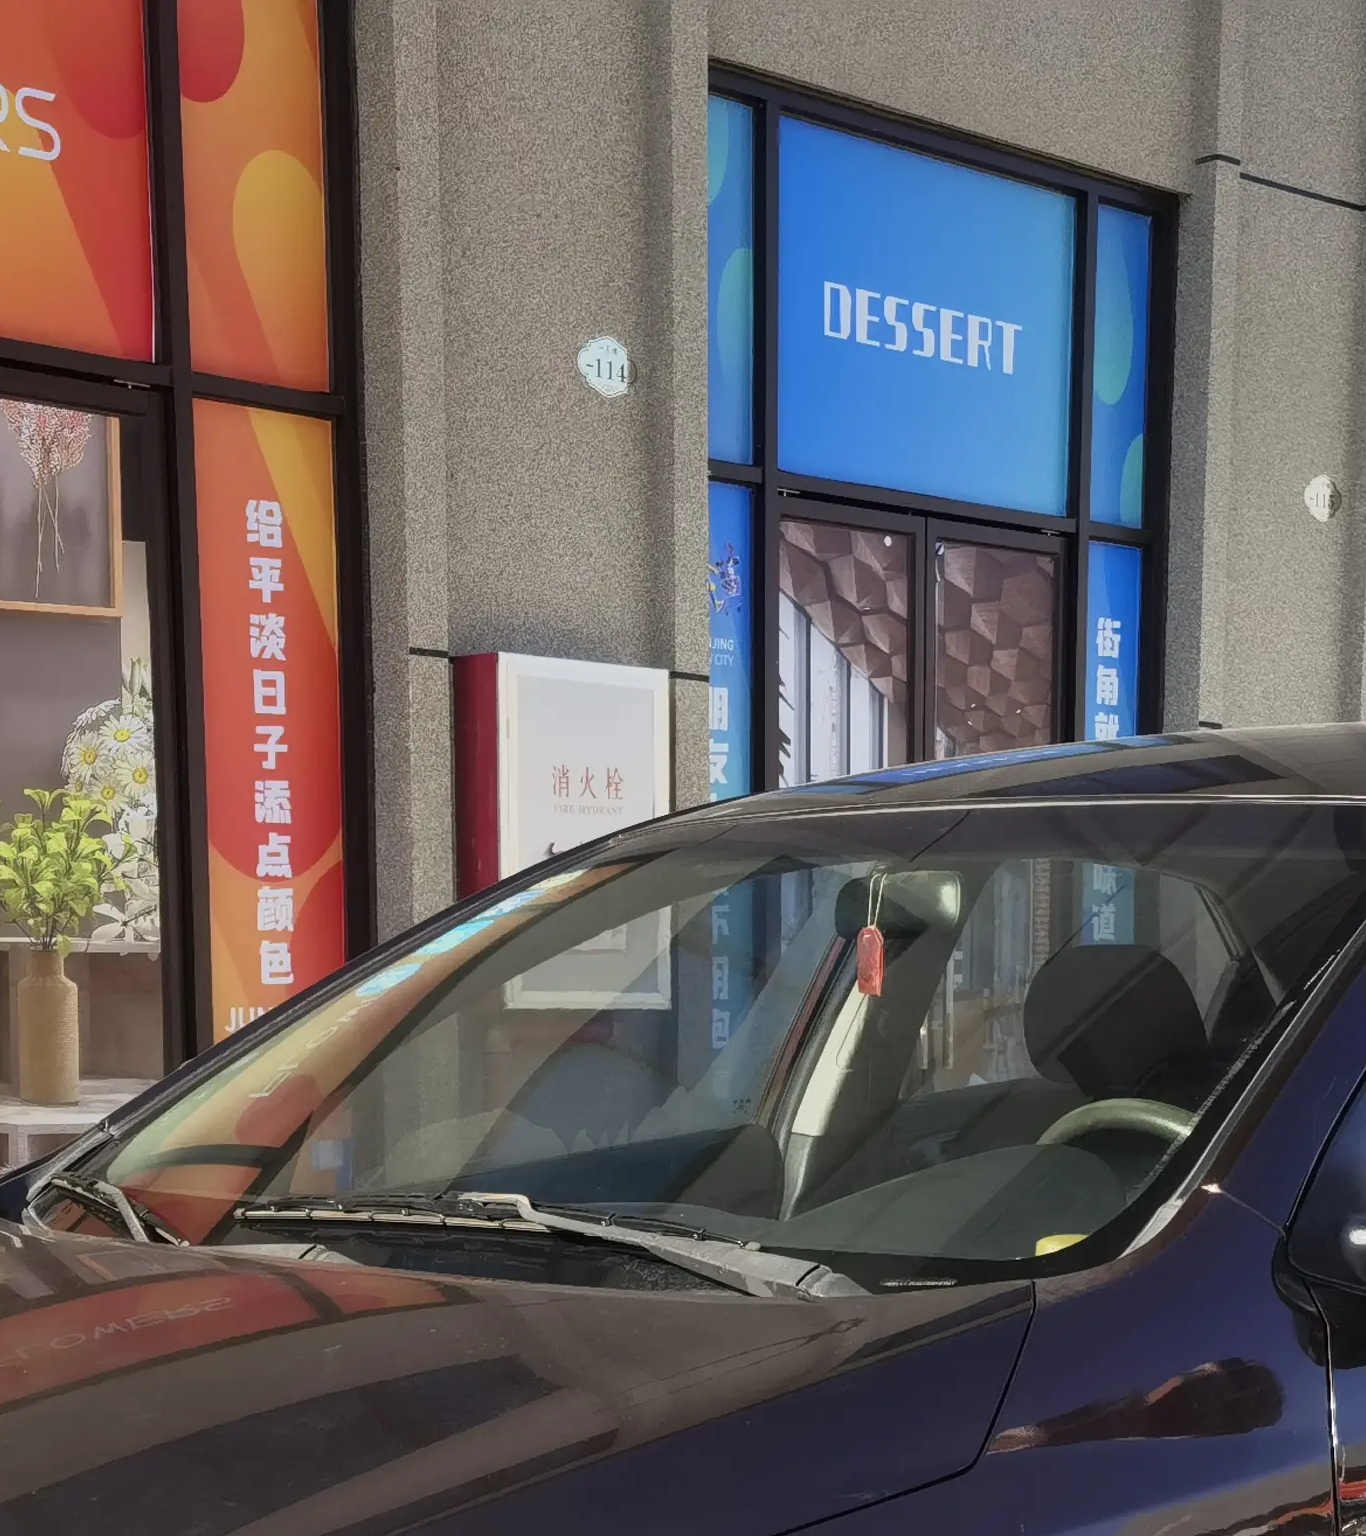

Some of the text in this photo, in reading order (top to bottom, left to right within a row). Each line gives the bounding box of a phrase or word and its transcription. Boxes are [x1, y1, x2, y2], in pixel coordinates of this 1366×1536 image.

[822, 280, 1023, 375] DESSERT
[585, 358, 627, 384] -114
[245, 499, 295, 986] 给平淡日子添点颜色
[550, 764, 623, 800] 消火栓
[553, 804, 575, 815] FIRE
